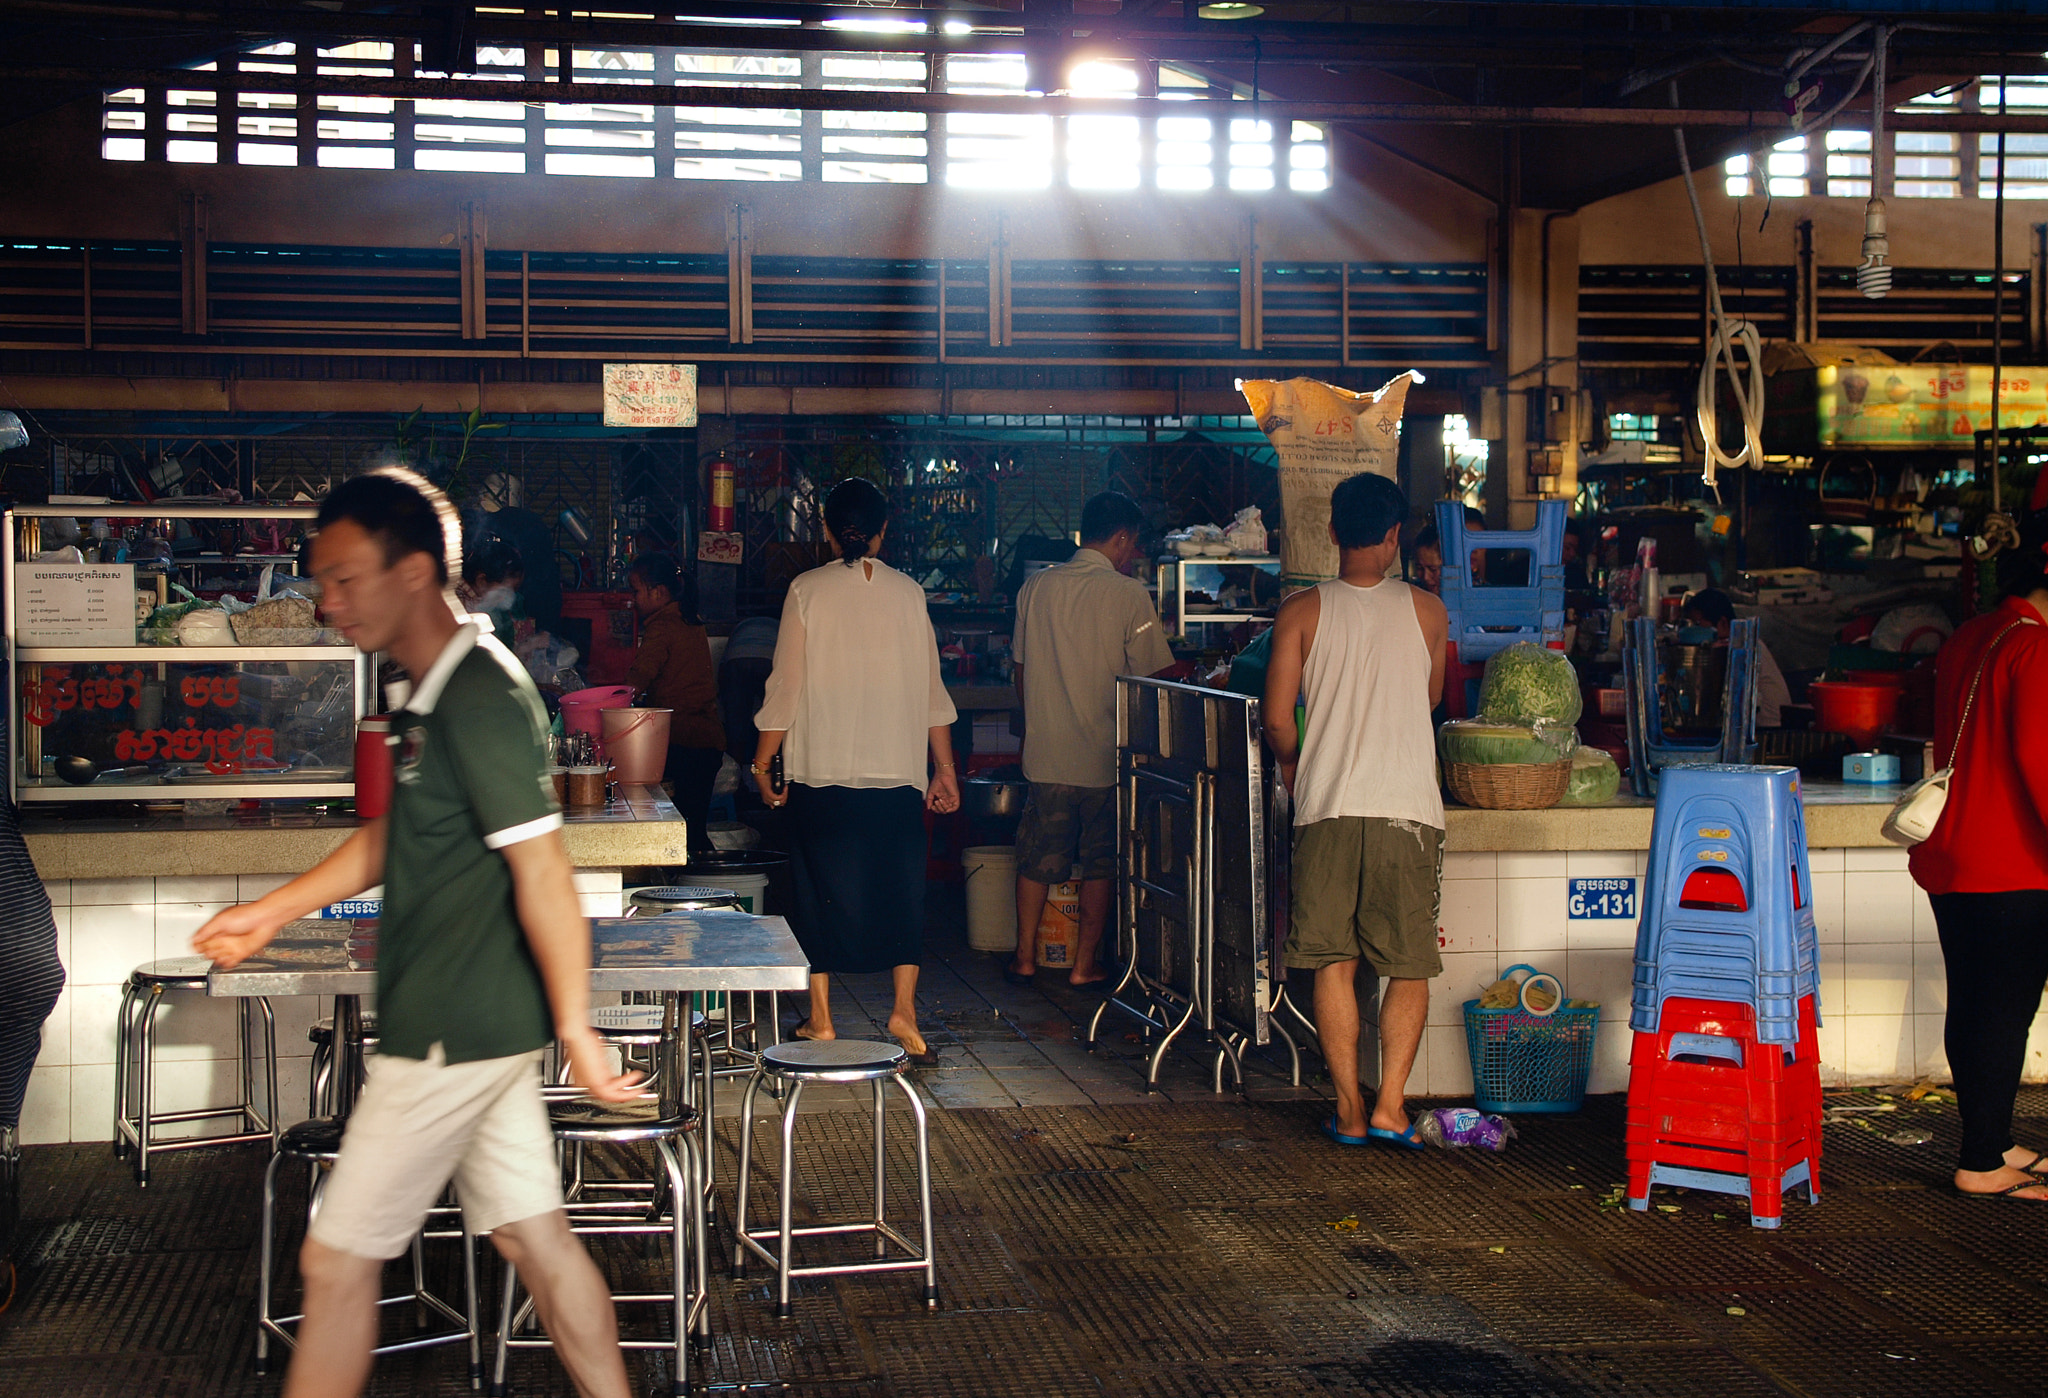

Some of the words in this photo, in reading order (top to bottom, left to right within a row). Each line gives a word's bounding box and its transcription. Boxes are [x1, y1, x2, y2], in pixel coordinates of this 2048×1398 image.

[1309, 453, 1339, 463] SUGAR
[1575, 879, 1629, 895] តូបលេខ
[330, 902, 384, 919] តូបលេ
